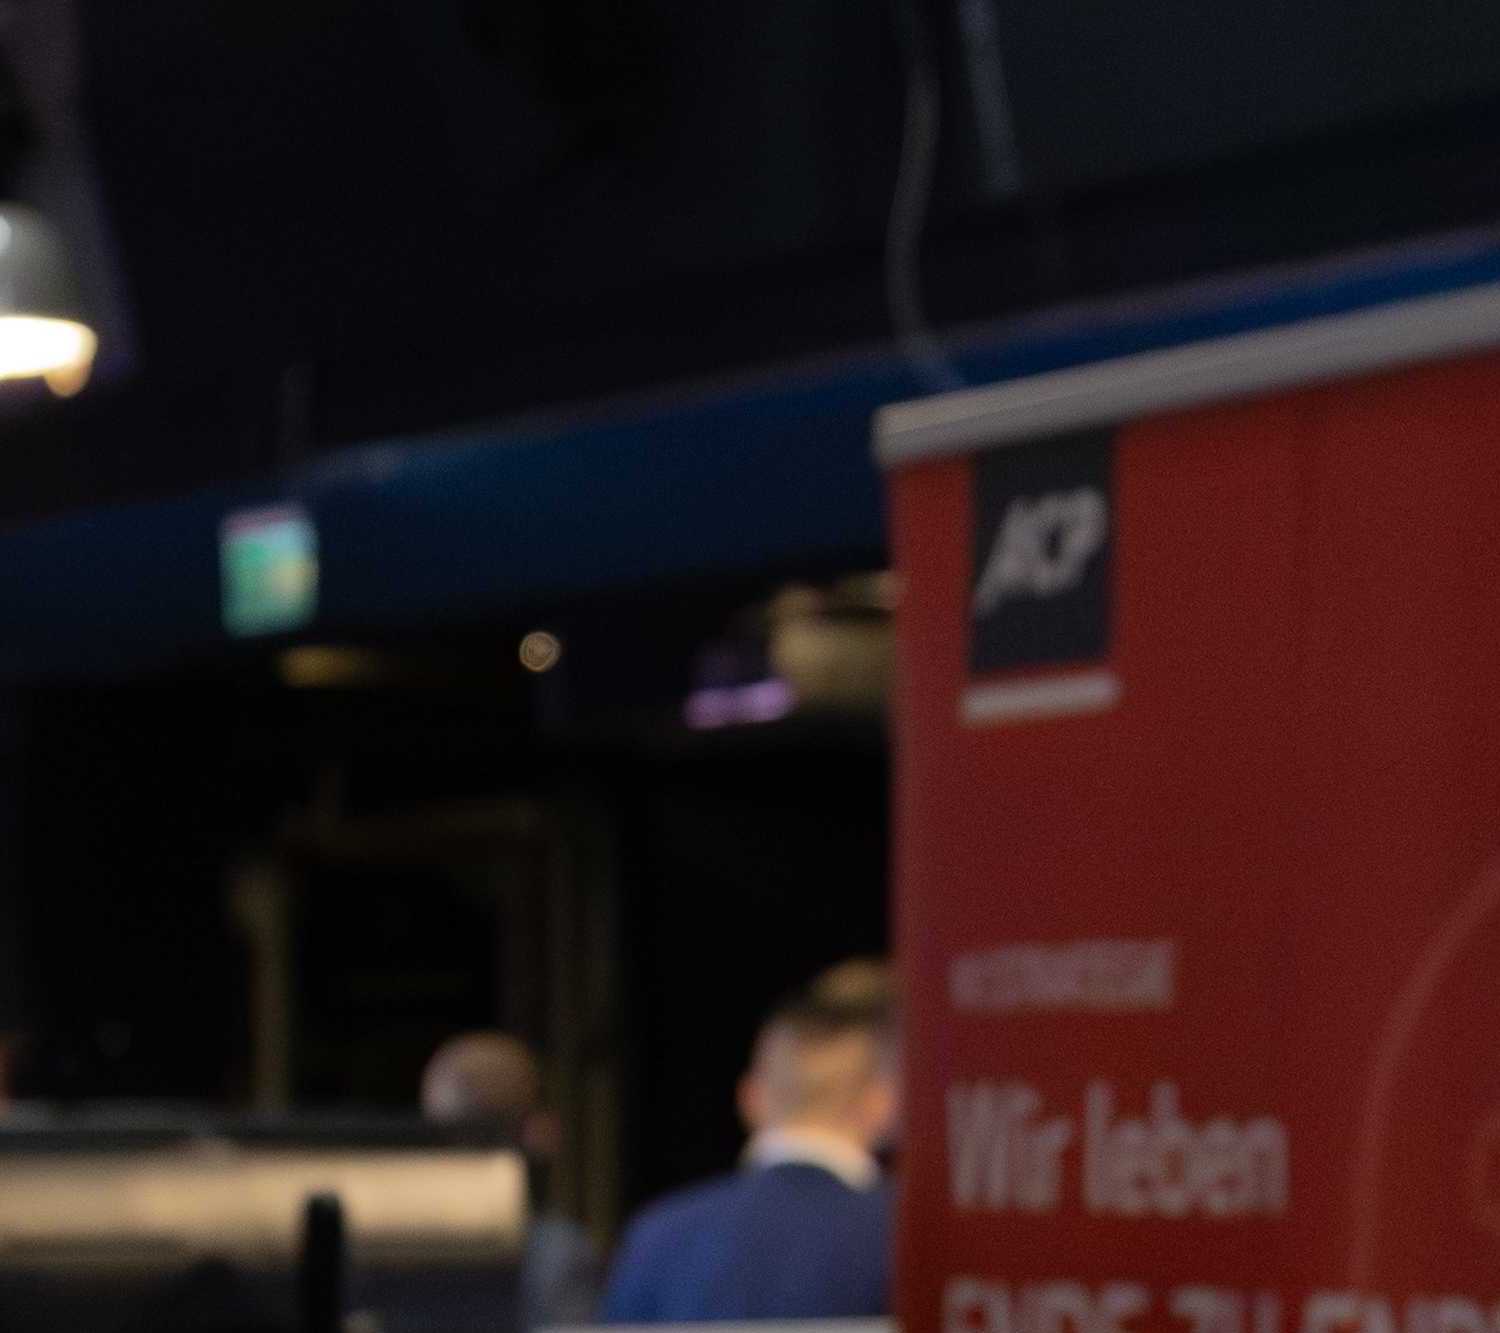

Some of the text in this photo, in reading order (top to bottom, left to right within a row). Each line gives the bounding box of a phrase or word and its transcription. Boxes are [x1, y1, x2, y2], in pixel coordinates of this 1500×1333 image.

[972, 488, 1107, 615] ACP
[946, 1078, 1291, 1218] Wir leben
